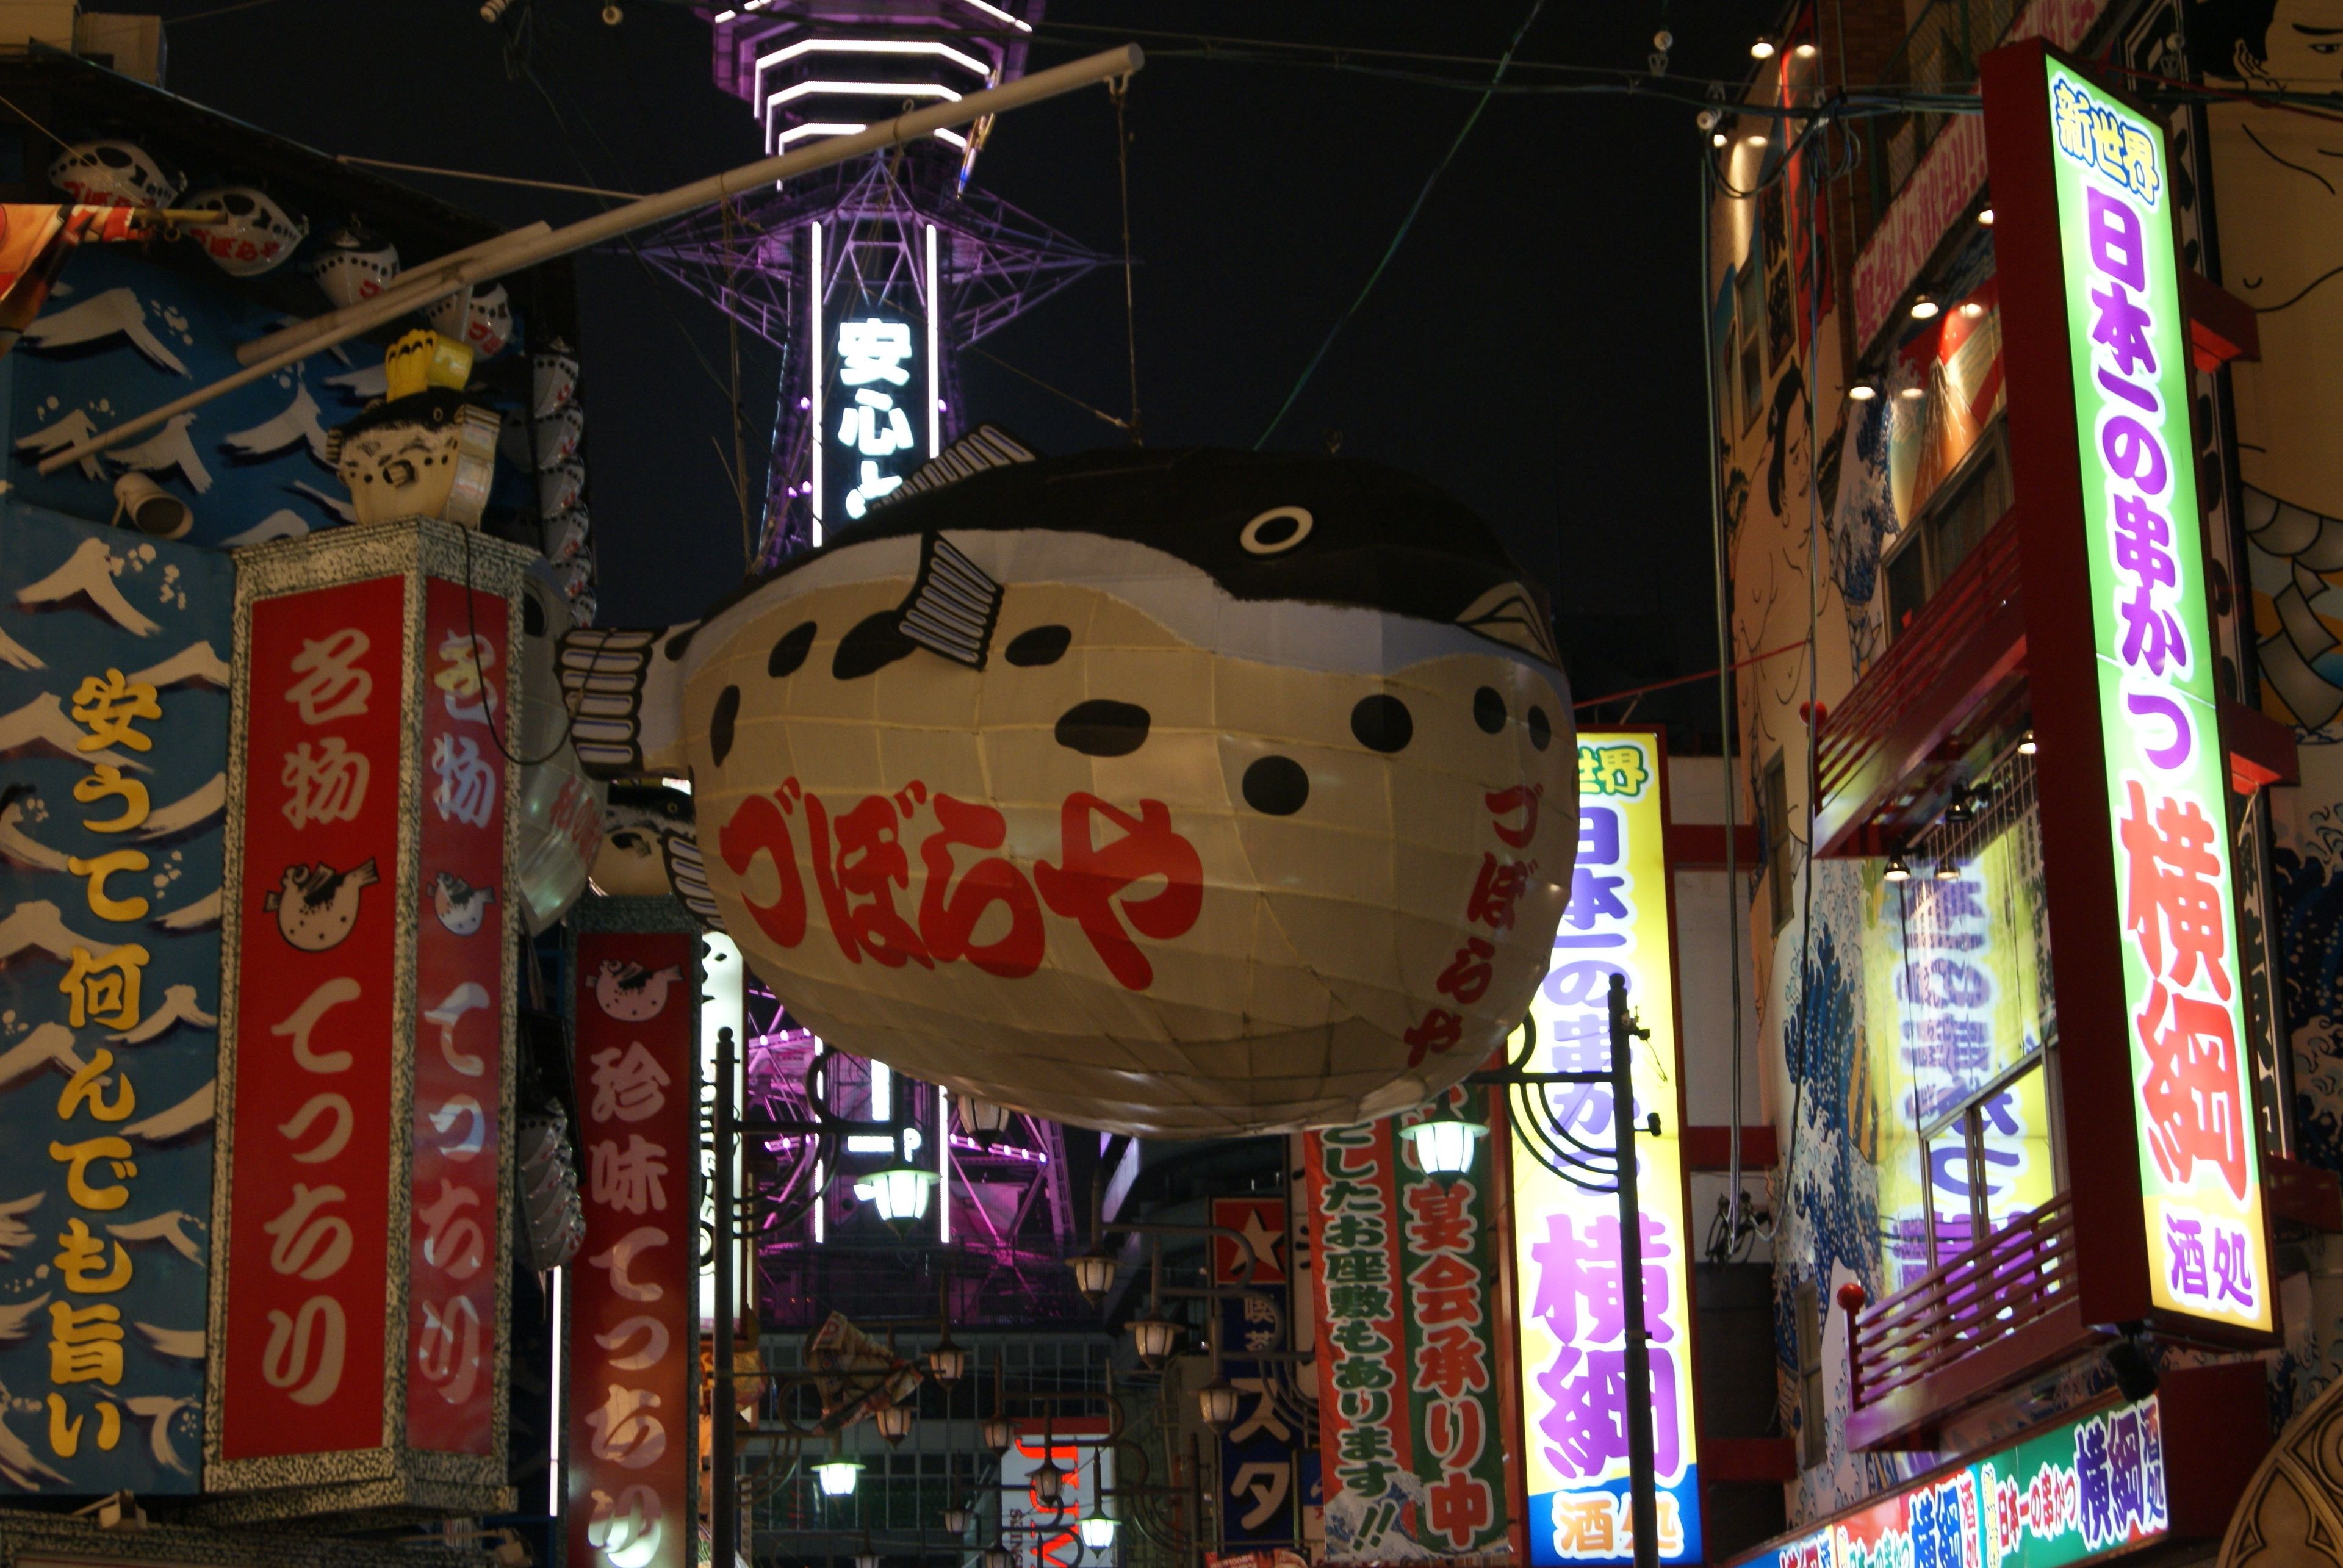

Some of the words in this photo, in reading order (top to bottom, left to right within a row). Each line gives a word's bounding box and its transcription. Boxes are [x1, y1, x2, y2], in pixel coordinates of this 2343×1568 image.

[2053, 79, 2160, 206] 新世界
[2087, 185, 2192, 769] 日本一の串かつ
[281, 628, 373, 830] 名物
[431, 628, 498, 829] 名物
[719, 776, 1204, 991] づぼらや
[1404, 782, 1544, 1069] づぼらや
[2120, 779, 2248, 1202] 横綱
[46, 667, 162, 1458] 安うて何んでも旨い
[1403, 1115, 1494, 1550] 宴会承り中
[1531, 1212, 1681, 1480] 横綱
[2167, 1212, 2254, 1307] 酒処
[1998, 1470, 2076, 1548] 日本一の串かつ
[2076, 1412, 2145, 1544] 横綱
